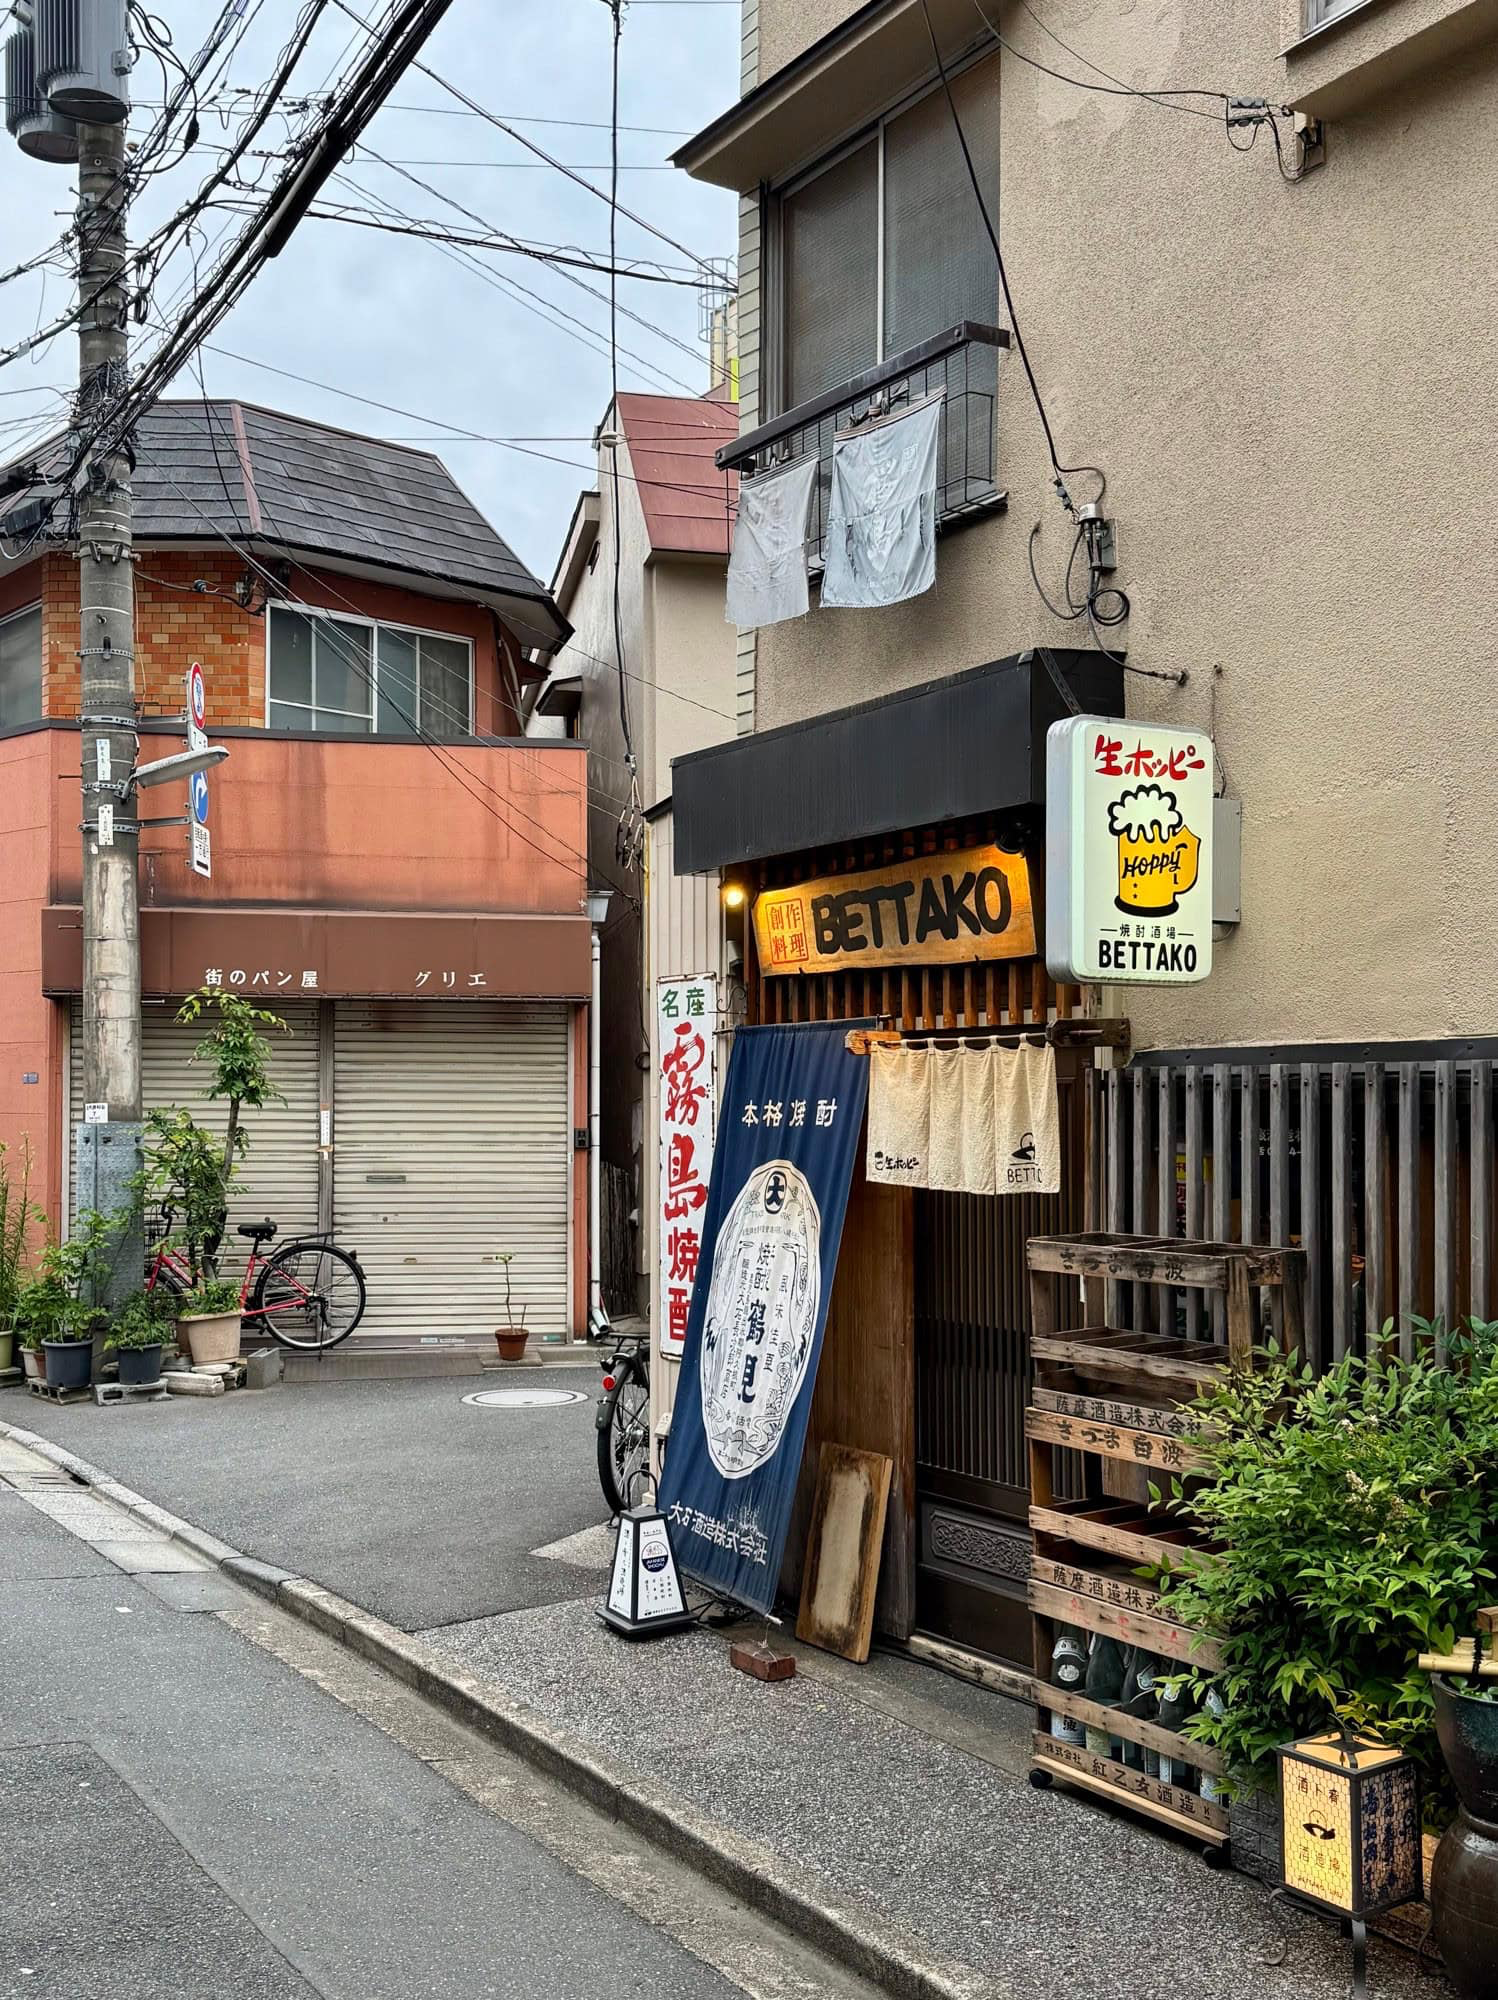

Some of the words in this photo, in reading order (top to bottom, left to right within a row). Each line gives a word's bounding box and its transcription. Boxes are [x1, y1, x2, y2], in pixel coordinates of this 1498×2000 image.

[1095, 734, 1205, 781] 生ホッピー
[770, 903, 801, 931] 創作
[811, 866, 1012, 955] BETTAKO
[772, 932, 806, 961] 料理
[1119, 923, 1176, 940] 焼酎酒場
[1099, 939, 1197, 972] BETTAKO
[205, 968, 319, 989] 街のパン屋
[415, 970, 487, 988] グリエ
[661, 988, 705, 1019] 名産
[742, 1097, 837, 1128] 本格焼酎
[767, 1173, 786, 1206] 大
[1057, 1420, 1183, 1467] さつま白波
[668, 1500, 769, 1566] 大石酒造株式会社
[1092, 1758, 1196, 1815] 紅乙女酒造
